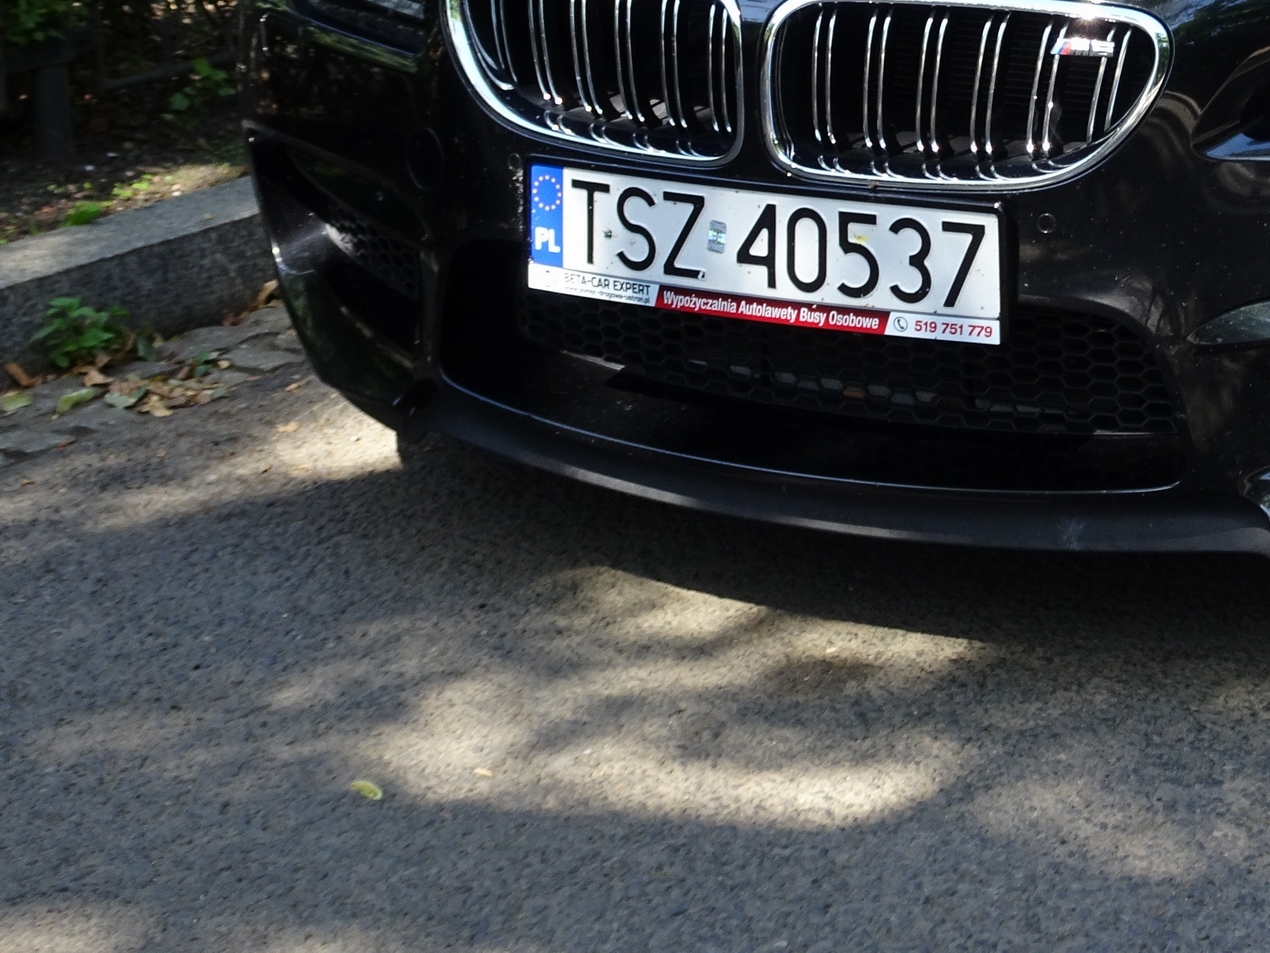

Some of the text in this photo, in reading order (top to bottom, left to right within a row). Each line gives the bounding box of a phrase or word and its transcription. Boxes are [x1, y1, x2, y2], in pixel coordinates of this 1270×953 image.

[534, 226, 561, 254] PL
[571, 178, 986, 308] TSZ 40537
[564, 272, 651, 296] BETA-CAR EXPERT
[663, 290, 880, 329] Wypożyczalnia Autolawety Busy Osobowe
[914, 320, 993, 338] 519 751 779
